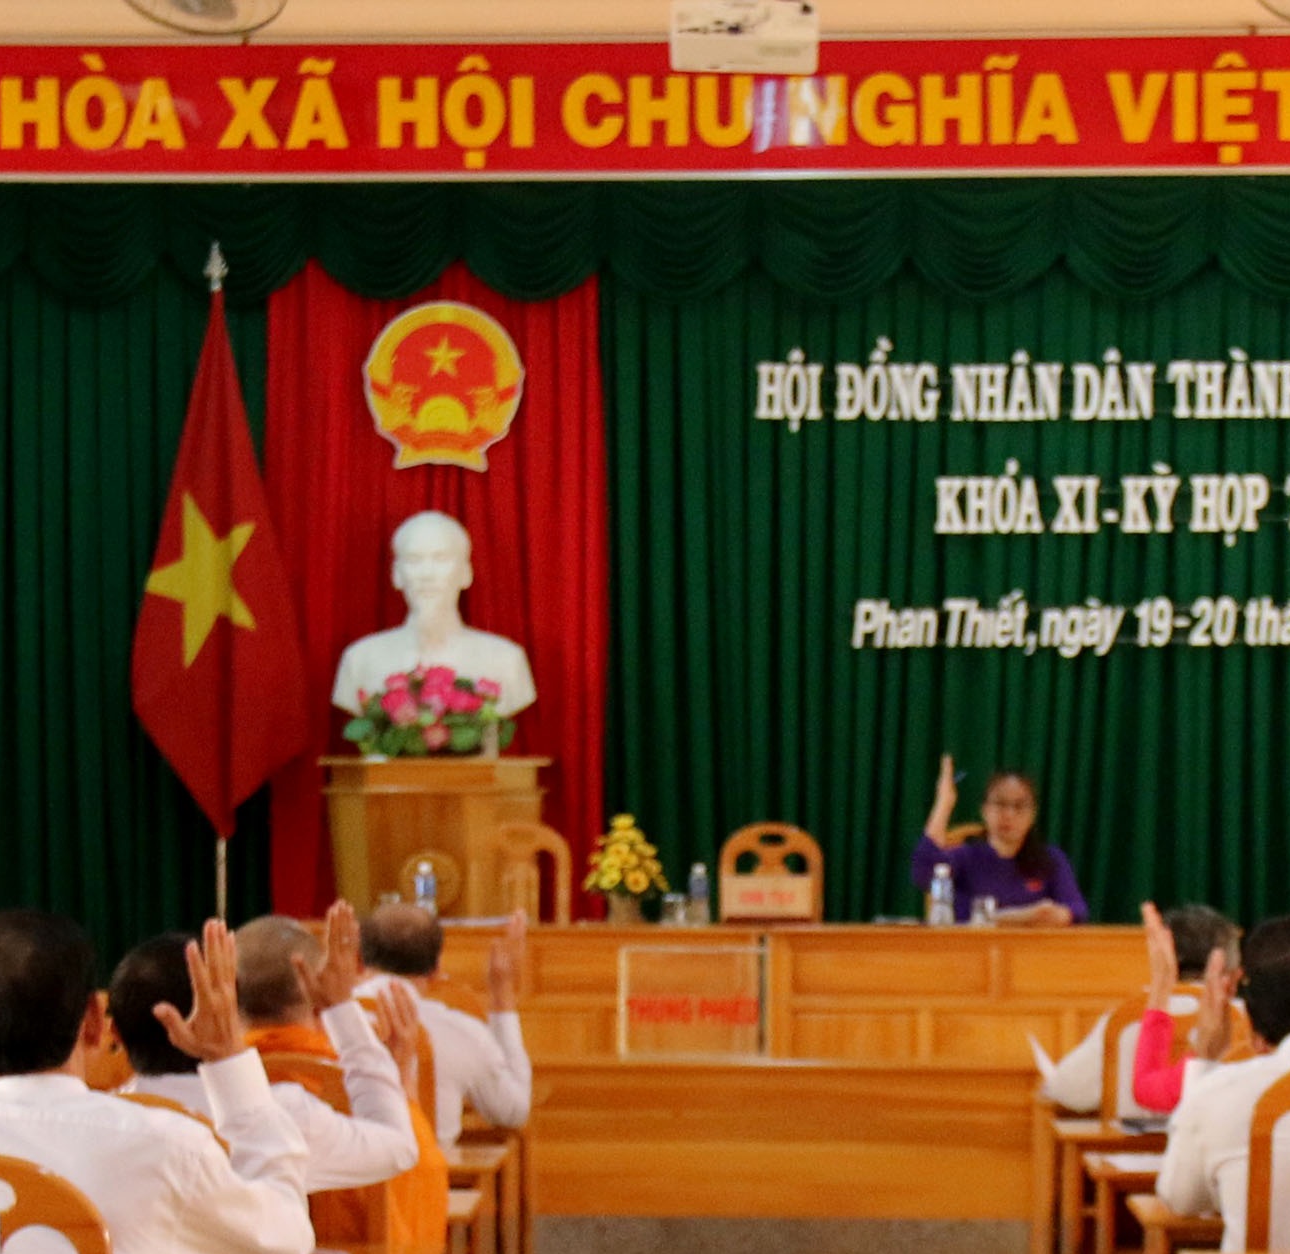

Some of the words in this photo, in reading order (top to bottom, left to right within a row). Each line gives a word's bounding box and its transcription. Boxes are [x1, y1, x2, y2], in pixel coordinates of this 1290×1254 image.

[218, 58, 349, 149] XÃ
[377, 56, 535, 169] HỘI
[788, 55, 1079, 148] NGHĨA
[755, 346, 823, 433] HỘI
[835, 335, 941, 422] ĐỒNG
[949, 348, 1063, 422] NHÂN
[1071, 346, 1156, 421] DÂN
[1188, 473, 1269, 548] HỌP
[852, 598, 938, 649] Phan
[1039, 597, 1125, 658] ngày
[1133, 595, 1238, 647] 19-20
